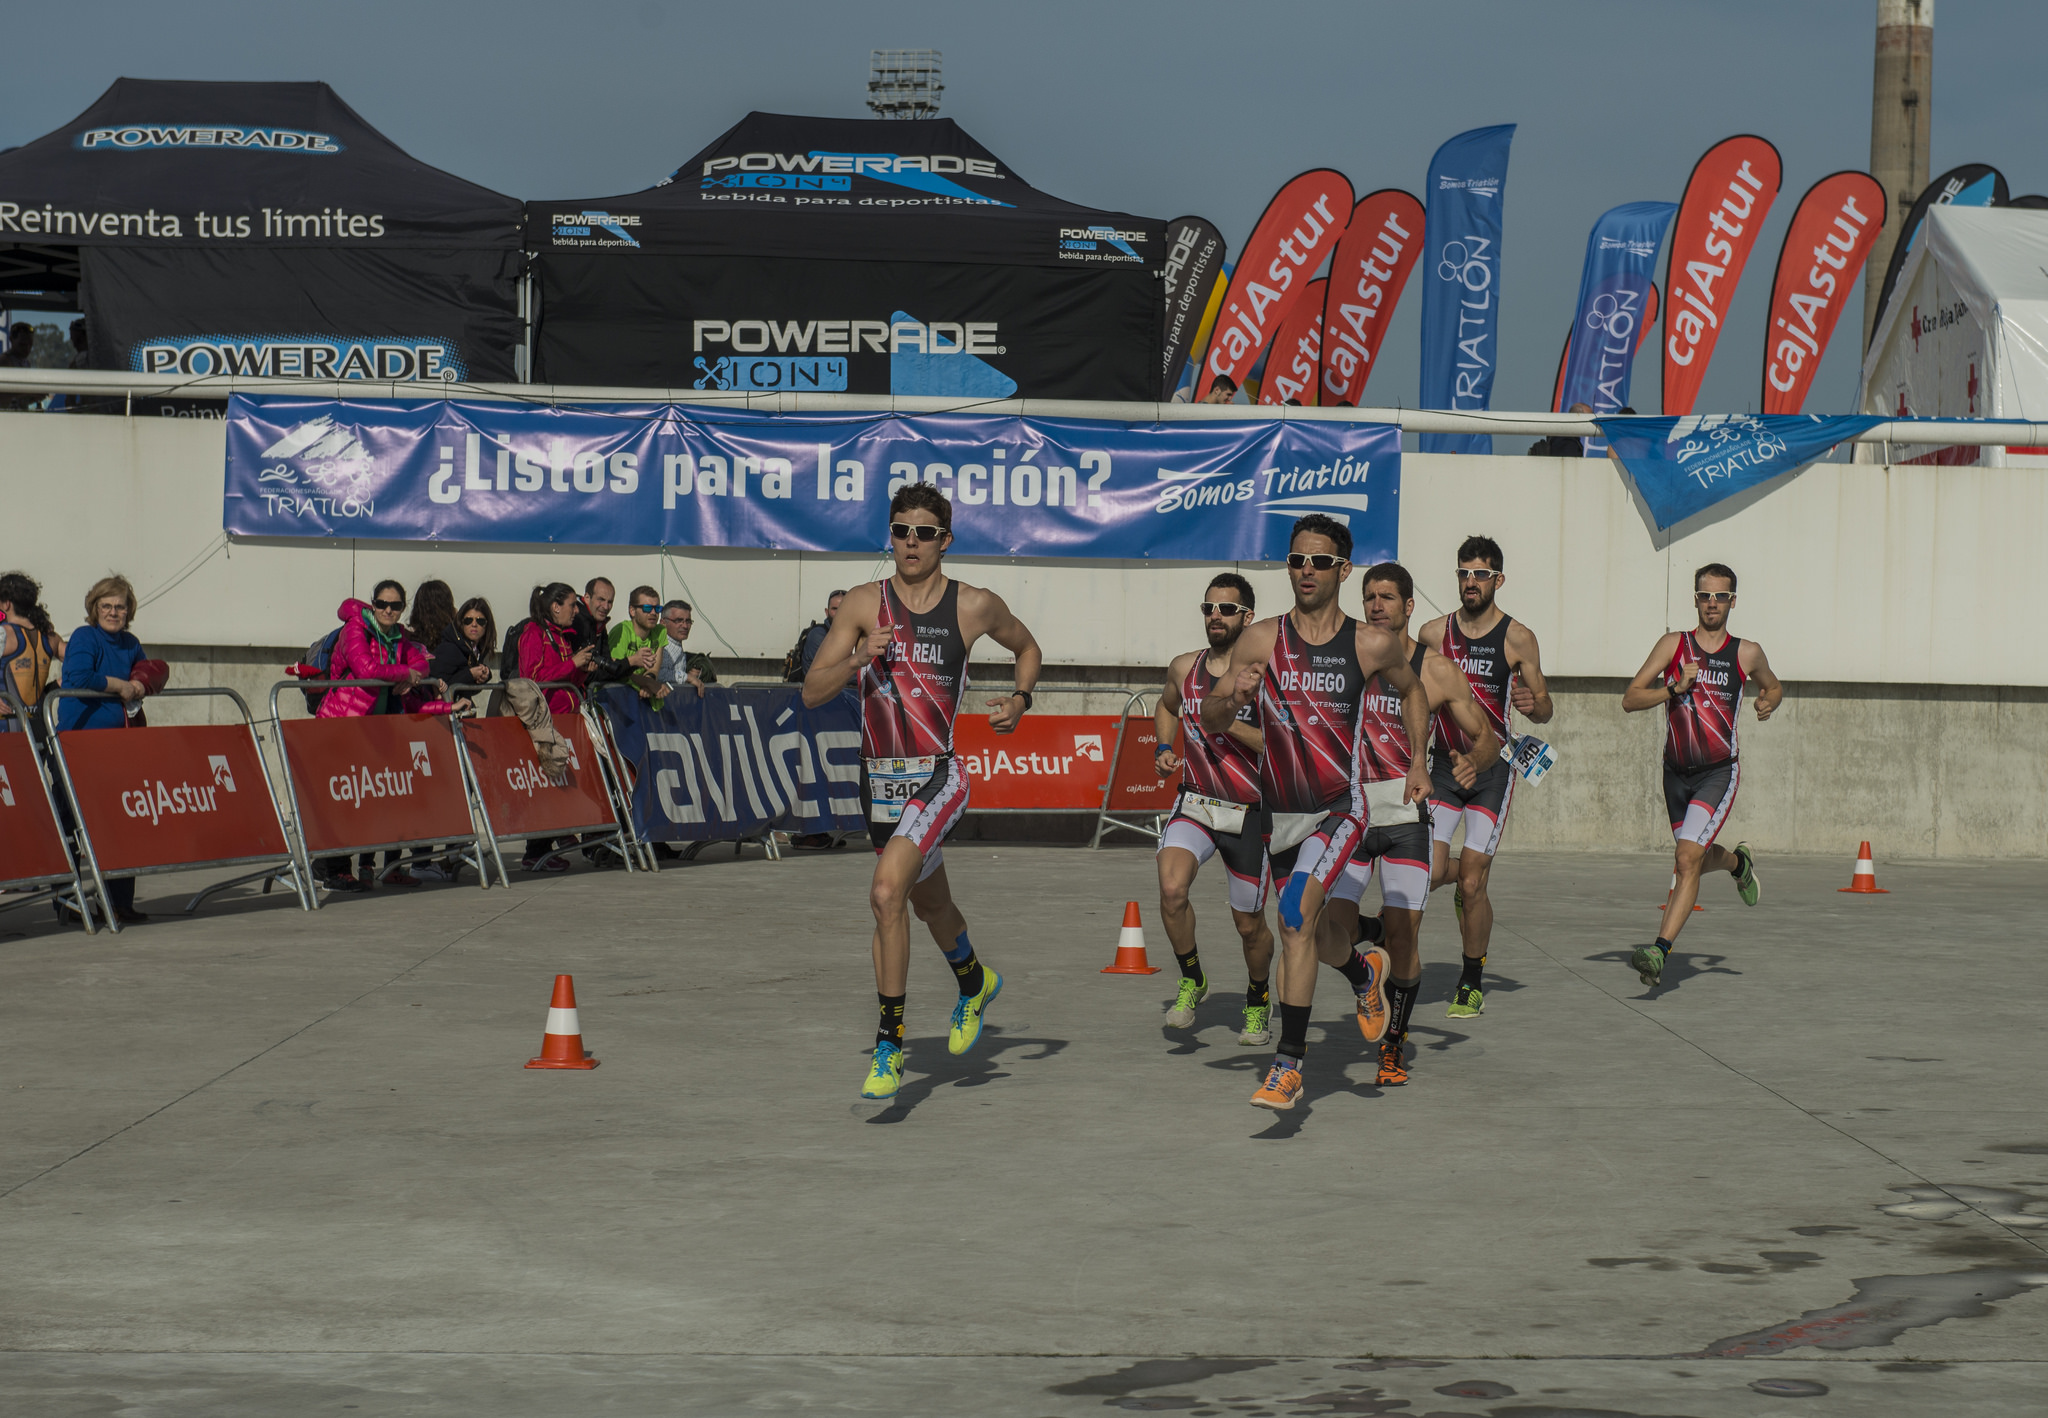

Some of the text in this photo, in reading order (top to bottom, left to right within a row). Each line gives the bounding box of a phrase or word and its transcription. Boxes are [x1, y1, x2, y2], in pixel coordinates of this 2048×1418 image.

[82, 126, 332, 151] POWERADE
[702, 152, 998, 179] POWERADE
[700, 192, 1002, 208] bebida para deportistas
[0, 202, 386, 239] Reinventa tus límites
[552, 214, 641, 226] POWERADE
[1060, 228, 1147, 242] POWERADE
[552, 237, 640, 248] bebida para deportistas
[1058, 251, 1084, 260] bebida
[1085, 253, 1102, 262] para
[1667, 159, 1764, 367] cajAstur
[1169, 313, 1186, 345] para
[1178, 238, 1217, 312] deportistas
[1210, 193, 1335, 376] cajAstur
[1767, 195, 1869, 393] cajAstur
[1324, 211, 1411, 397] cajAstur
[693, 319, 999, 355] POWERADE
[142, 344, 445, 380] POWERADE
[427, 432, 1114, 510] ¿Listos para la acción?
[1688, 437, 1788, 489] TRIATLÓN
[1154, 454, 1371, 514] Somos Triatlón
[259, 494, 375, 518] TRIATLÓN
[886, 641, 945, 665] DEL REAL
[1280, 670, 1346, 694] DE DIEGO
[646, 703, 862, 826] avilés
[120, 780, 218, 826] cajAstur
[328, 763, 414, 809] cajAstur
